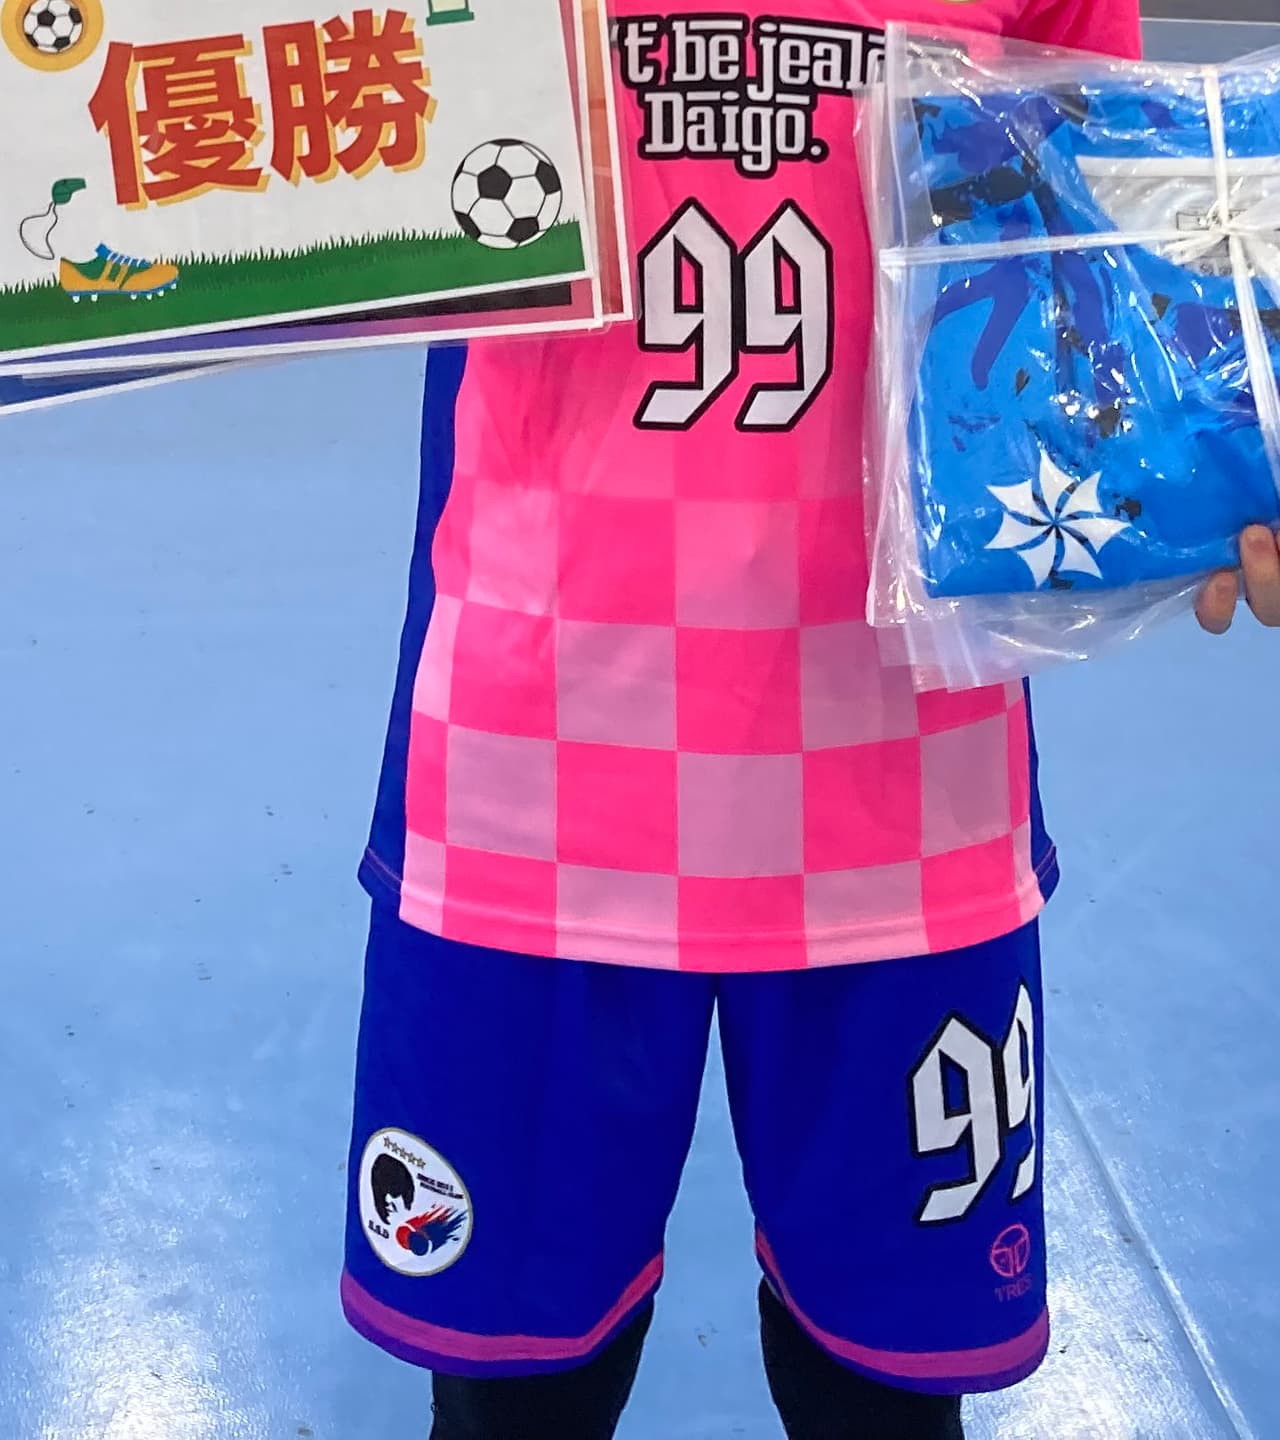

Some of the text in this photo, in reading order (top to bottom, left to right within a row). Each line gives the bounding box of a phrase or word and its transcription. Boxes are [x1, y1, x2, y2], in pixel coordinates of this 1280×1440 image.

[88, 7, 439, 211] 優勝
[672, 18, 745, 84] be
[642, 89, 824, 174] Daigo.
[636, 200, 832, 428] 99
